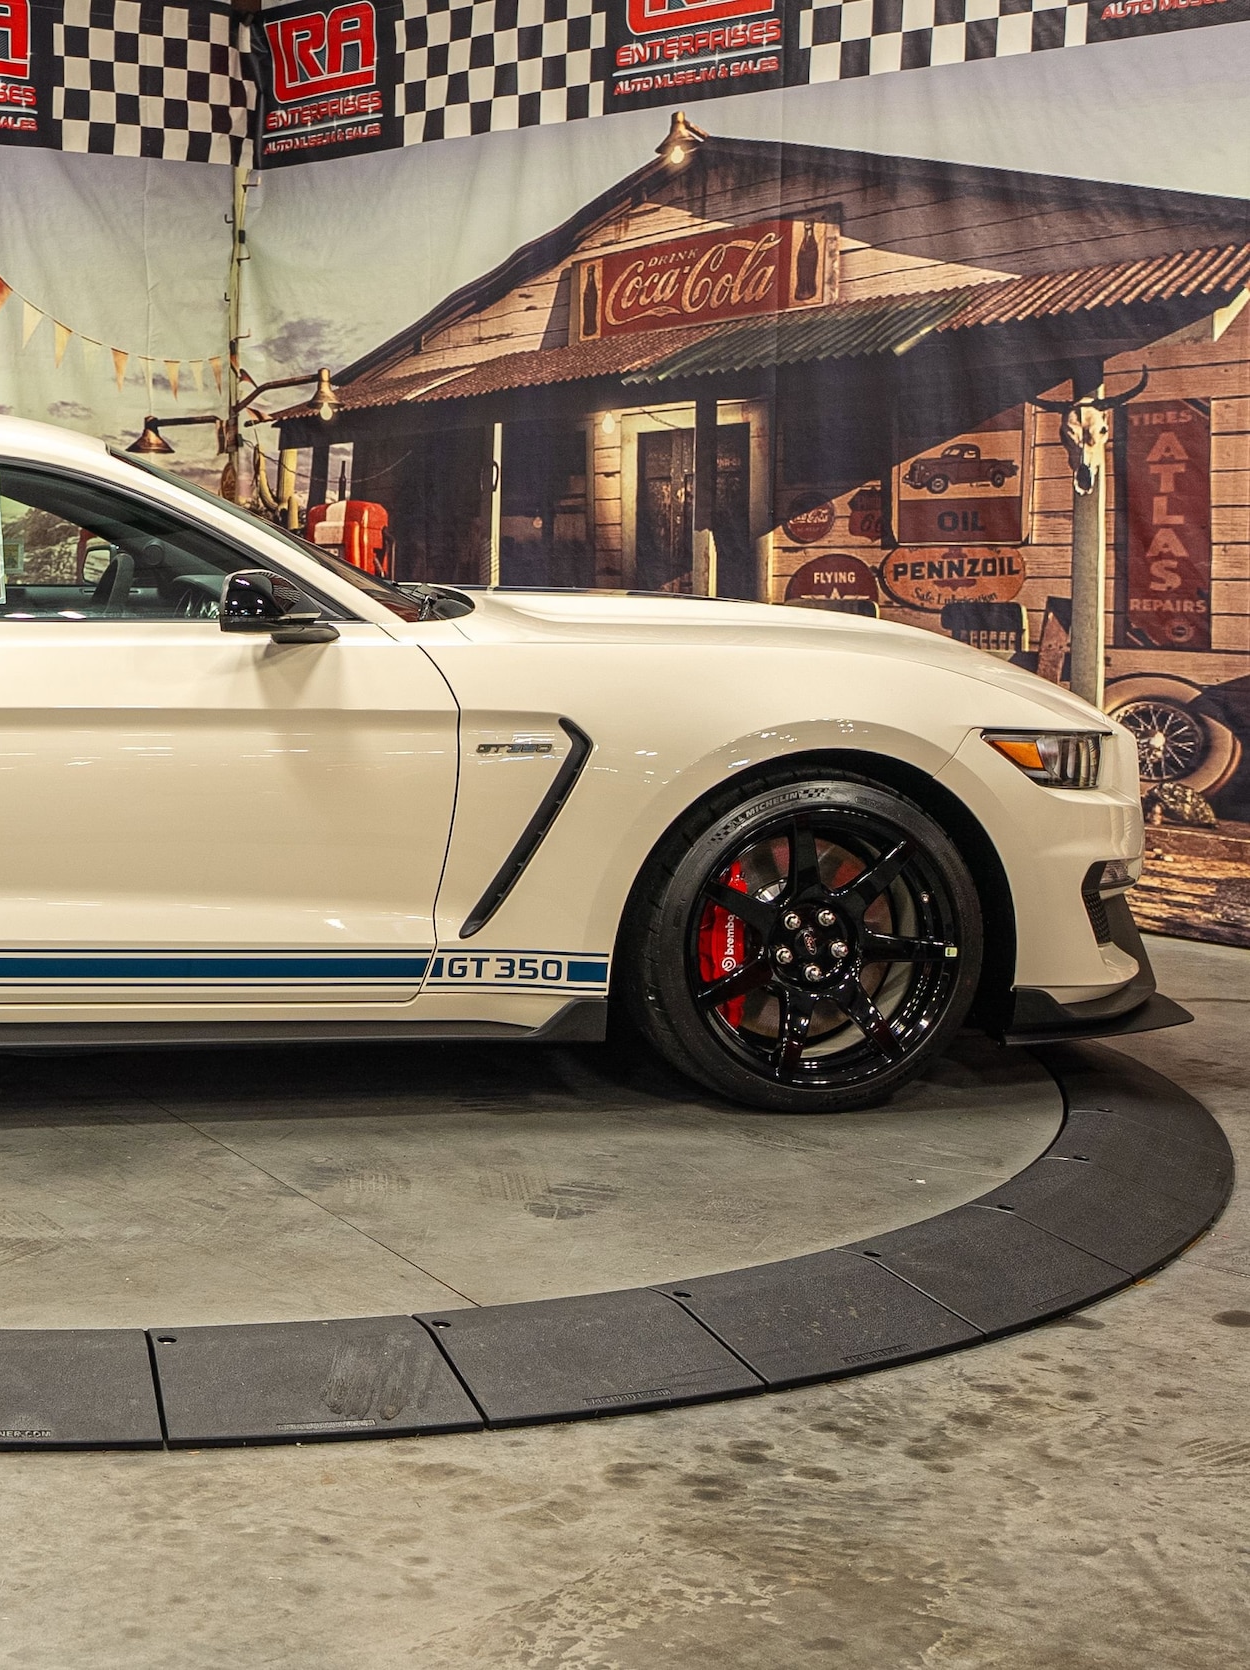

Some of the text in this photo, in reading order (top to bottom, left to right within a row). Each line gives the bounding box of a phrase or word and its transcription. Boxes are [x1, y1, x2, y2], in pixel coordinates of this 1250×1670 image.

[1101, 0, 1157, 20] AUTO
[615, 18, 781, 67] ENTERPRISES
[613, 56, 779, 96] AUTO MUSEUM & SALES
[266, 90, 383, 130] ENTERPRISES
[263, 137, 293, 155] AUTO
[648, 248, 699, 267] DRINK
[605, 233, 783, 326] Coca-Cola
[1130, 410, 1192, 426] TIRES
[937, 510, 987, 532] OIL
[1146, 432, 1189, 592] ATLAS
[813, 571, 856, 584] FLYING
[893, 556, 1021, 582] PENNZOIL
[1130, 599, 1207, 613] REPAIRS
[746, 791, 799, 818] MICHELIN
[724, 914, 736, 956] brembo
[447, 957, 563, 981] GT 350
